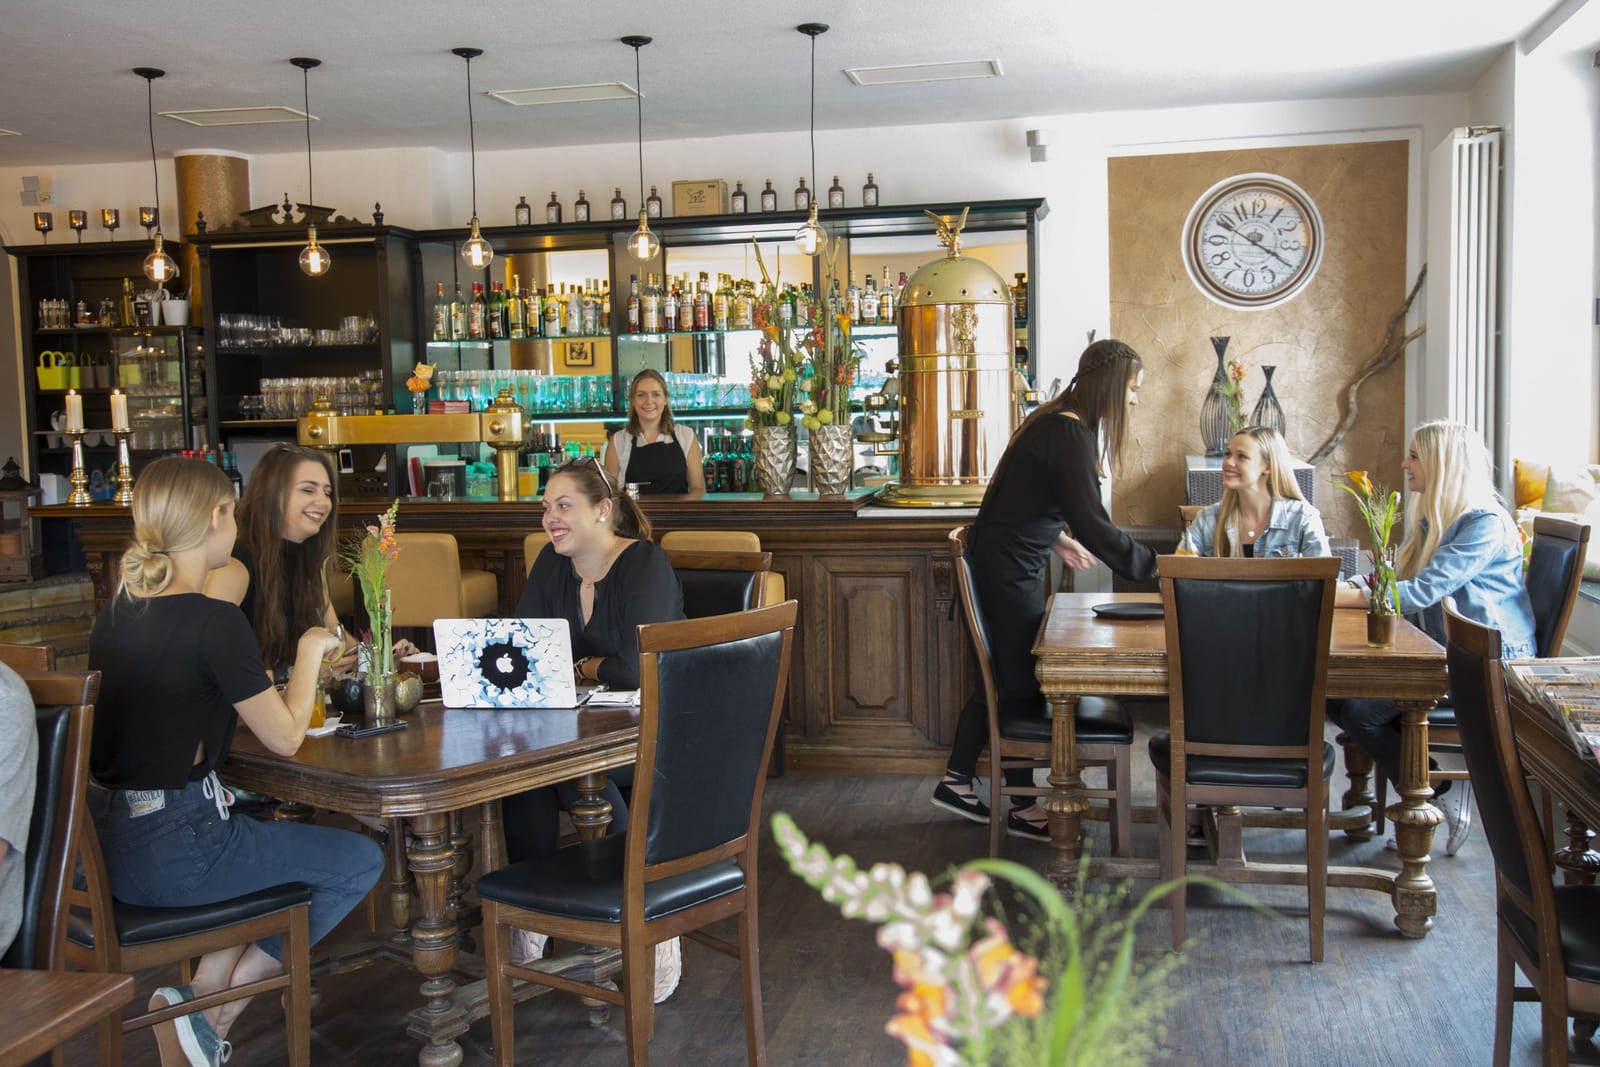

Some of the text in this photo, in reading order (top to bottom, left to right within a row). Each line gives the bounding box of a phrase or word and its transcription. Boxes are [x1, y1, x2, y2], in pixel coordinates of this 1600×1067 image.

[1233, 202, 1248, 222] 11
[1252, 198, 1267, 219] 12
[1270, 208, 1283, 223] 1
[1277, 220, 1297, 236] 2
[1208, 234, 1229, 247] 9
[1280, 240, 1301, 251] 3
[1211, 251, 1231, 266] 8
[1223, 262, 1242, 280] 7
[1243, 268, 1255, 287] 6
[1260, 265, 1276, 284] 5
